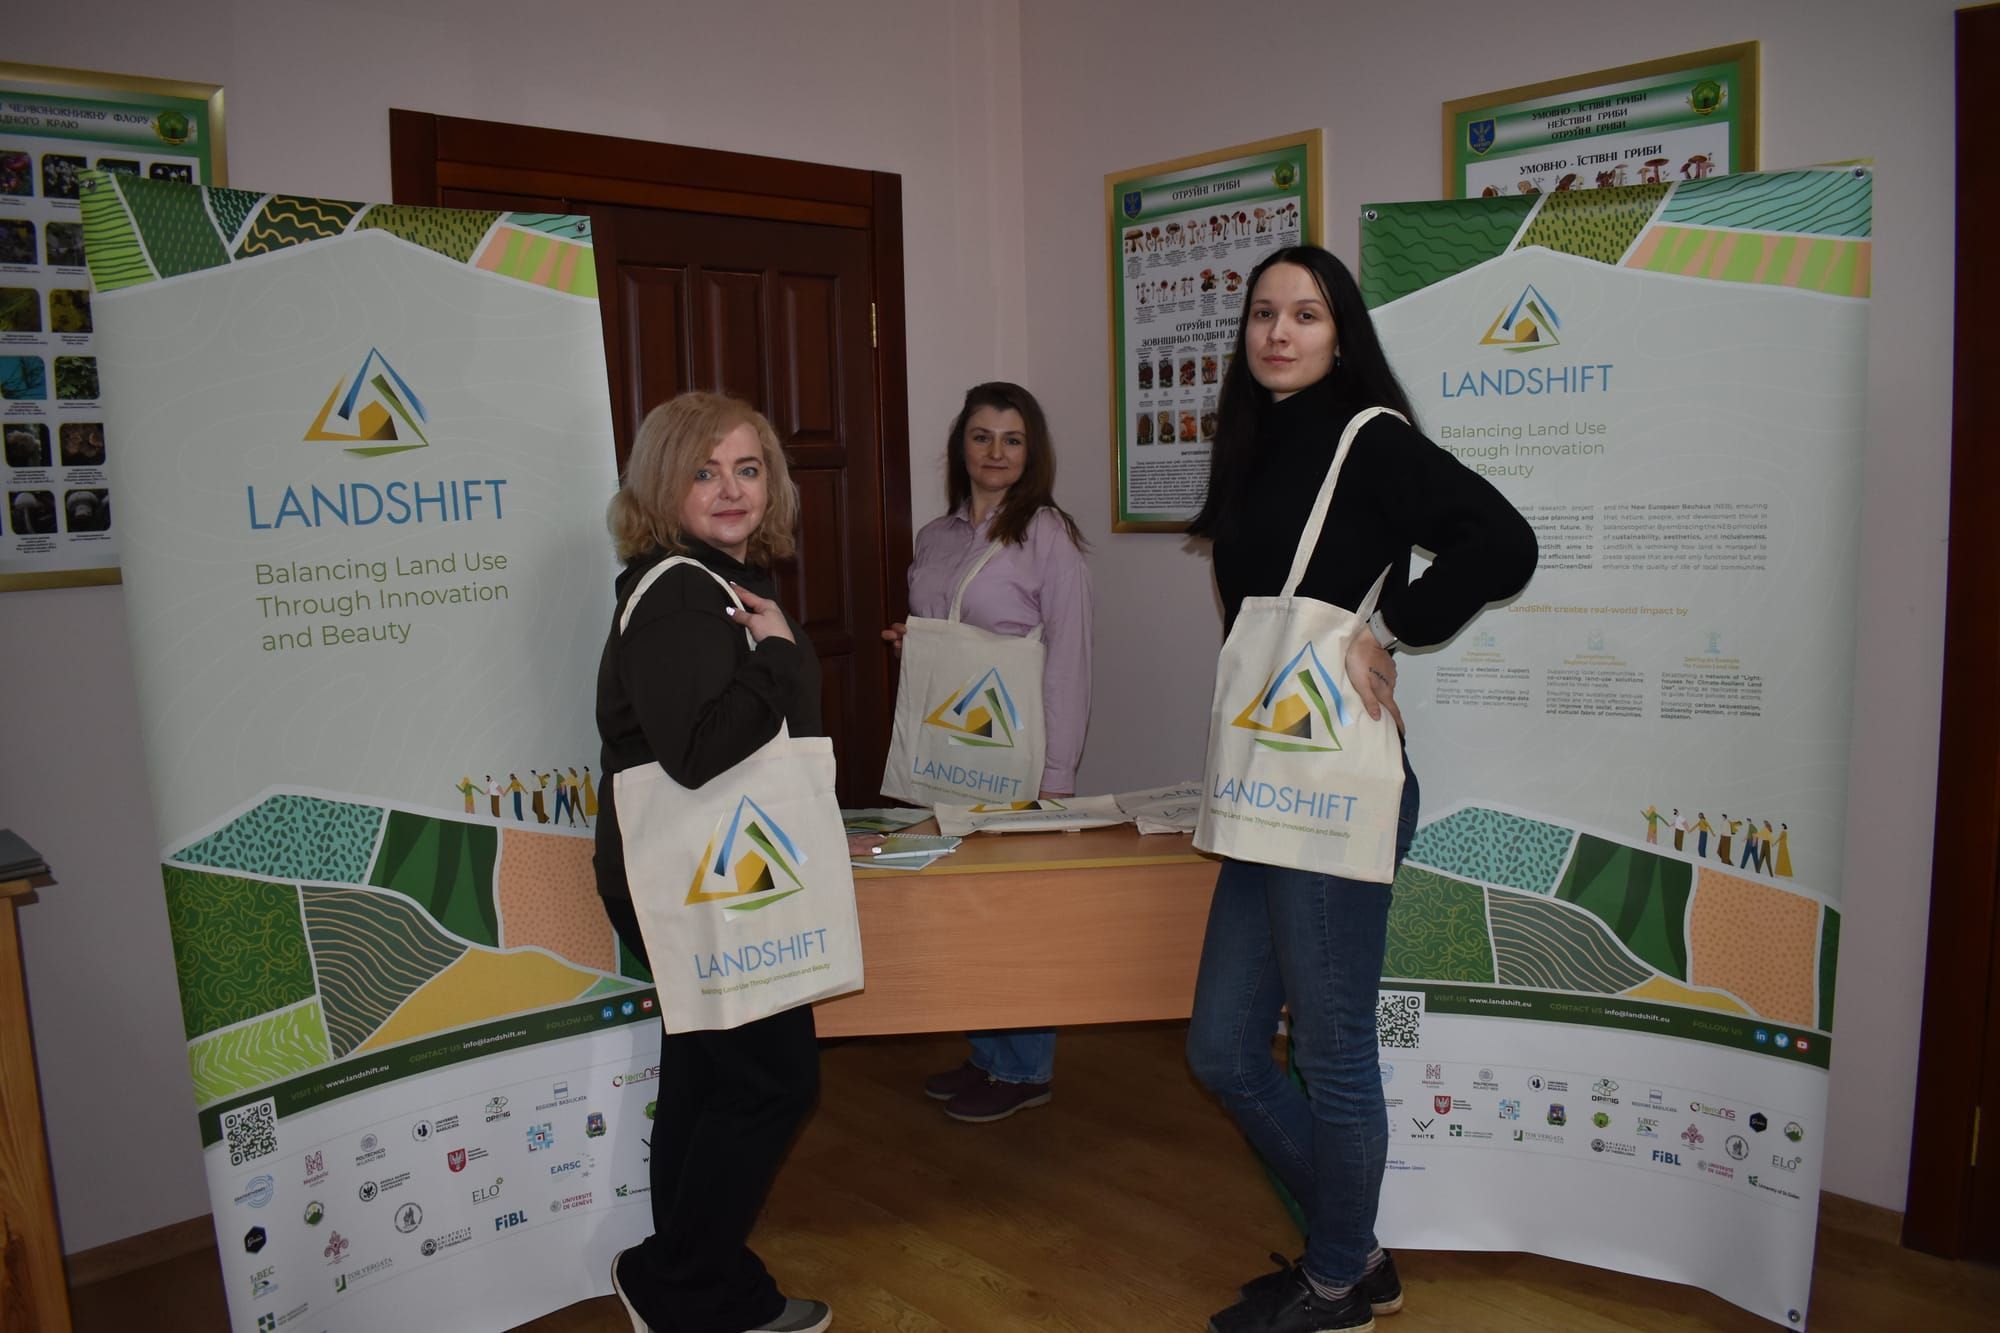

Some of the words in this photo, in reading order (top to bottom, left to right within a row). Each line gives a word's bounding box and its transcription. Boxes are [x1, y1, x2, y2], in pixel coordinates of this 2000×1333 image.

[1532, 106, 1570, 120] УМОВНО
[1617, 92, 1647, 105] ГРИБИ
[1598, 108, 1627, 121] ГРИБИ
[46, 120, 79, 130] КРАЮ
[113, 114, 150, 126] ФЛОРУ
[1596, 121, 1626, 133] ГРИБИ
[1520, 159, 1566, 175] УМОВНО
[1577, 152, 1618, 166] ЇСТІВНІ
[1624, 145, 1662, 160] ГРИБИ
[1172, 186, 1208, 200] ОТРУЙНІ
[1212, 180, 1240, 193] ГРИБИ
[1176, 320, 1211, 332] ОТРУЙНІ
[1442, 364, 1614, 398] LANDSHIFT
[1440, 424, 1522, 440] Balancing
[1528, 422, 1570, 437] Land
[1575, 421, 1607, 436] Use
[1516, 441, 1604, 457] Innovation
[1476, 462, 1535, 479] Beauty
[247, 479, 507, 530] LANDSHIFT
[255, 559, 388, 586] Balancing
[396, 553, 456, 577] Land
[464, 552, 508, 573] Use
[256, 590, 371, 618] Through
[380, 582, 509, 610] Innovation
[1508, 604, 1552, 613] LandShift
[1554, 606, 1588, 614] creates
[1590, 606, 1638, 614] real-world
[1640, 606, 1674, 616] impact
[262, 626, 313, 652] and
[322, 622, 412, 646] Beauty
[912, 756, 1022, 797] LANDSHIFT
[1213, 773, 1358, 822] LANDSHIFT
[1254, 817, 1280, 828] Through
[694, 928, 828, 980] LANDSHIFT
[812, 962, 831, 972] Beauty
[1469, 996, 1532, 1008] www.landshift.eu
[1550, 1002, 1590, 1012] CONTACT
[1604, 1008, 1670, 1024] info@landshift.eu
[1692, 1020, 1731, 1034] FOLLOW
[325, 1064, 390, 1089] www.landshift.eu
[409, 1046, 449, 1064] CONTACT
[462, 1029, 528, 1050] info@landshift.eu
[546, 1016, 581, 1031] FOLLOW
[535, 1102, 558, 1111] REGIONE
[550, 1160, 582, 1174] EARSC
[1652, 1150, 1681, 1166] FiBL
[1772, 1154, 1796, 1170] ELO
[472, 1184, 500, 1202] ELO
[494, 1210, 528, 1232] FiBL
[348, 1270, 360, 1280] TOR
[361, 1258, 393, 1274] VERGATA
